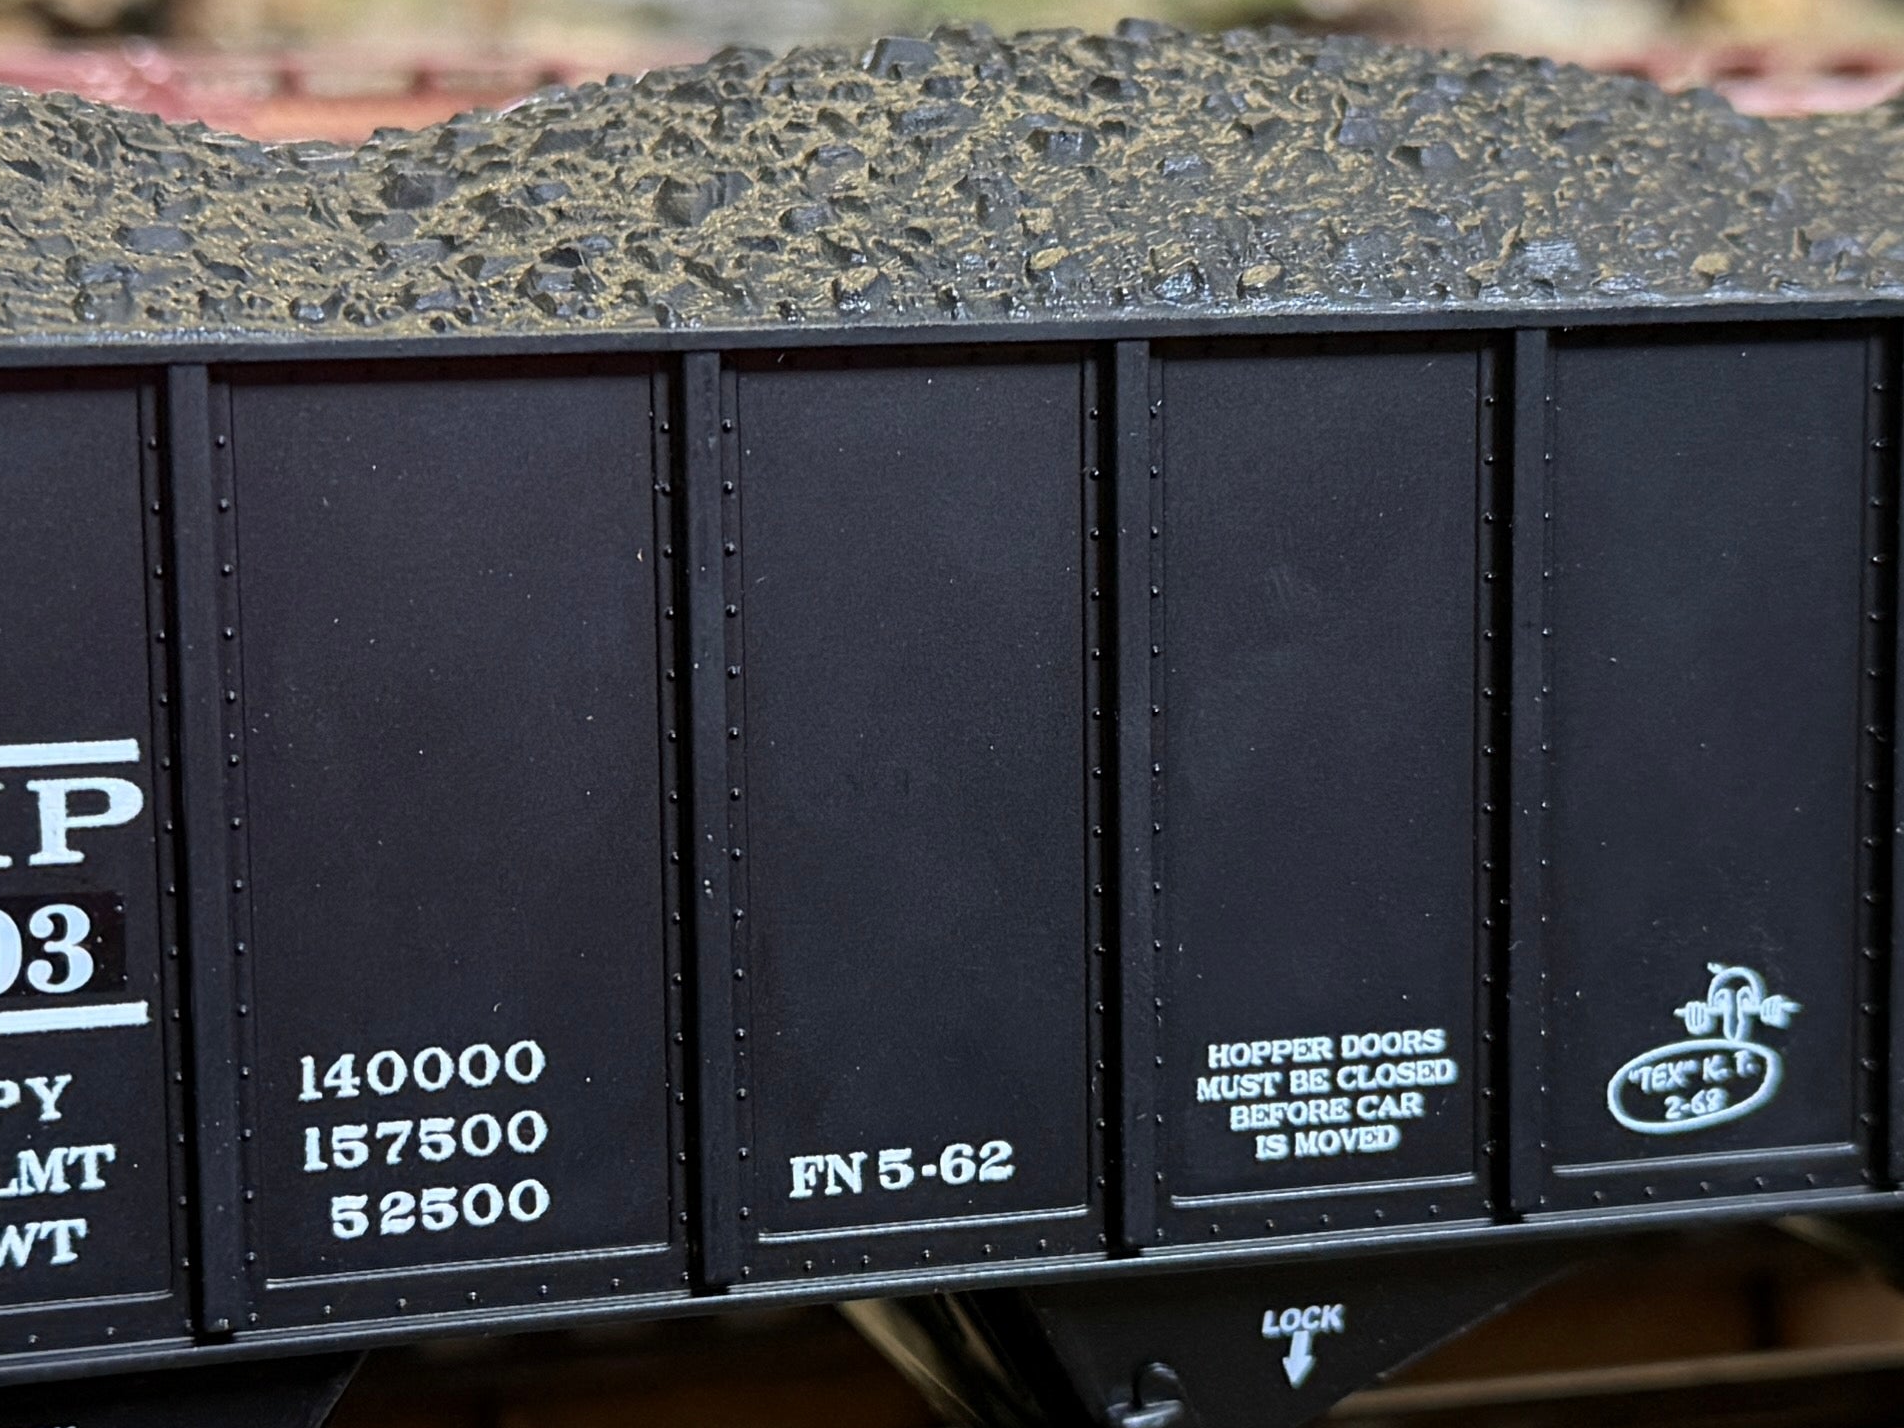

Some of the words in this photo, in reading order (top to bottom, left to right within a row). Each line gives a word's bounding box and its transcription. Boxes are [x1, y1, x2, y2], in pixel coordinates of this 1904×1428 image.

[298, 1039, 547, 1102] 140000
[1208, 1036, 1334, 1069] HOPPER
[1341, 1028, 1447, 1059] DOORS
[1196, 1071, 1283, 1103] MUST
[1289, 1067, 1331, 1095] BE
[1336, 1058, 1459, 1092] CLOSED
[1230, 1097, 1353, 1132] BEFORE
[1356, 1091, 1425, 1122] CAR
[303, 1109, 549, 1172] 157500
[1254, 1133, 1290, 1161] IS
[1294, 1124, 1402, 1157] MOVED
[789, 1151, 868, 1199] FN
[877, 1140, 1016, 1191] 5-62
[330, 1178, 551, 1239] 52500
[1260, 1303, 1344, 1336] LOCK
